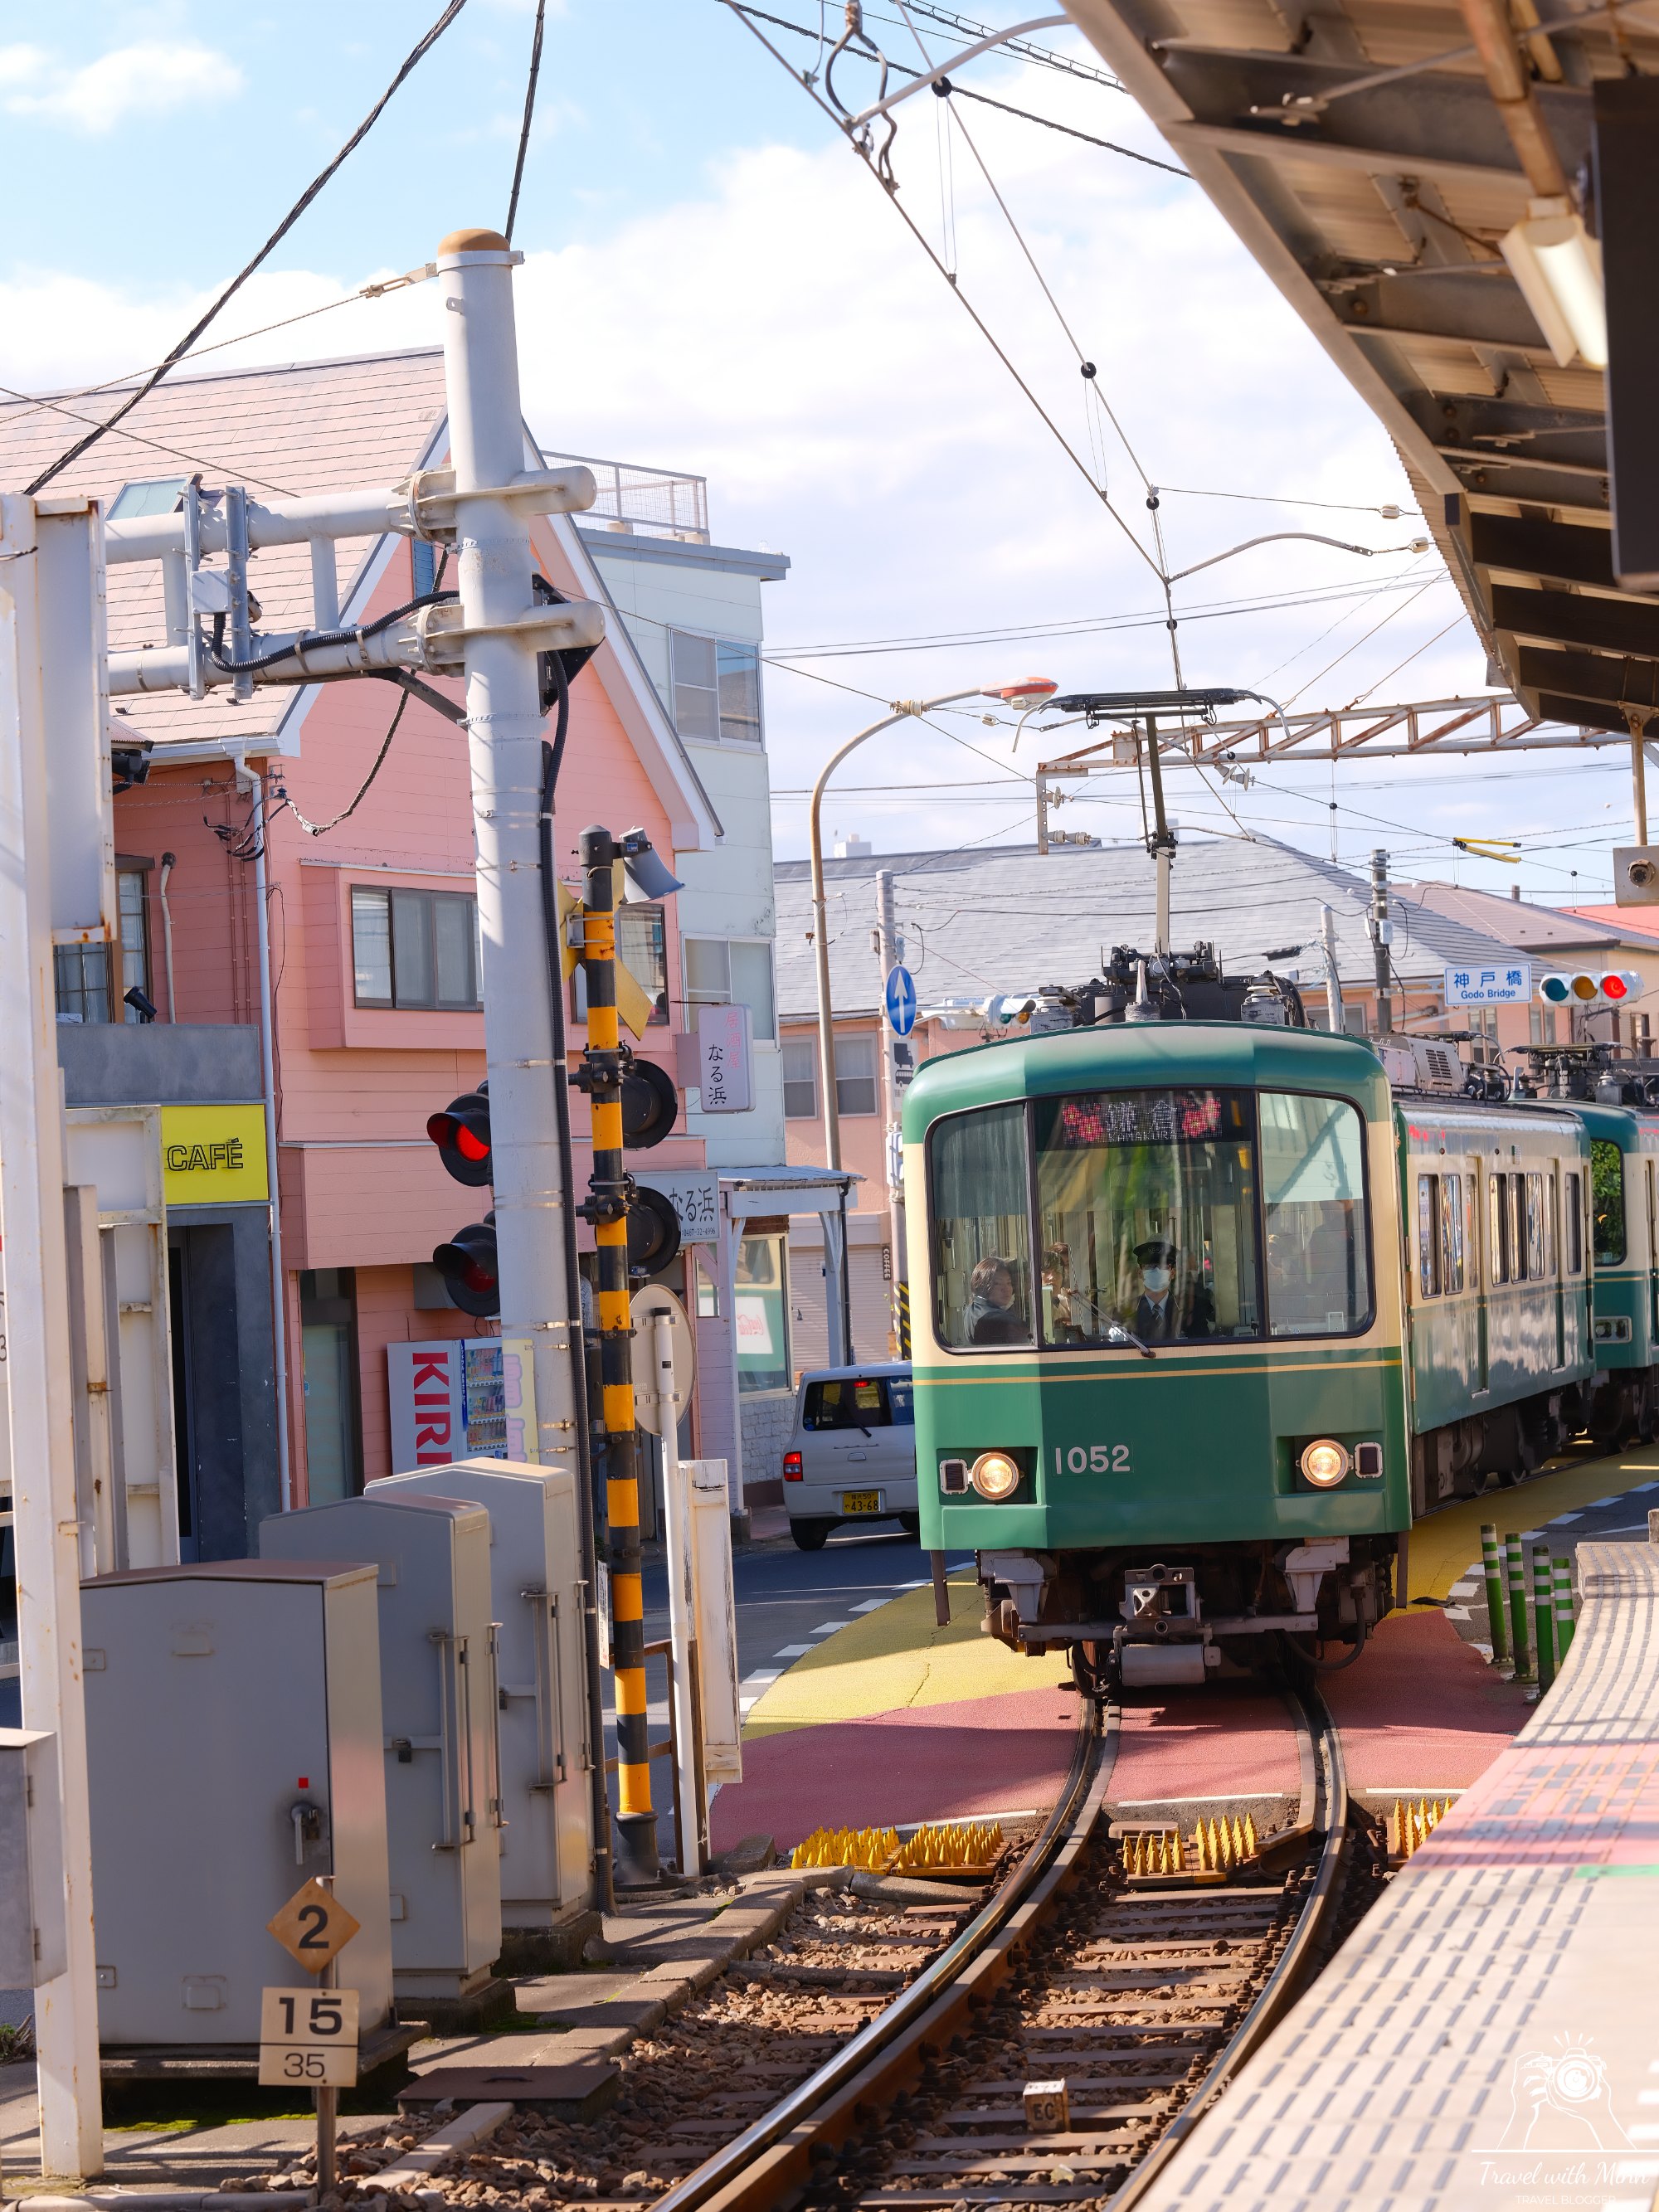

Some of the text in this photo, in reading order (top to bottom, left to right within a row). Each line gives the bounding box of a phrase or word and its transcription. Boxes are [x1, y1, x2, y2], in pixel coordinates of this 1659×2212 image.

[1453, 970, 1522, 989] 神戸橋
[1461, 989, 1516, 999] Godo Bridge
[724, 1011, 741, 1069] 居酒屋
[708, 1043, 727, 1106] なる浜
[167, 1137, 244, 1171] CAFÉ
[883, 1248, 891, 1279] COFFEE
[412, 1352, 453, 1466] KIRI
[1055, 1444, 1131, 1475] 1052
[851, 1500, 878, 1511] 43-68
[298, 1904, 329, 1949] 2
[279, 1997, 343, 2035] 15
[284, 2053, 325, 2078] 35
